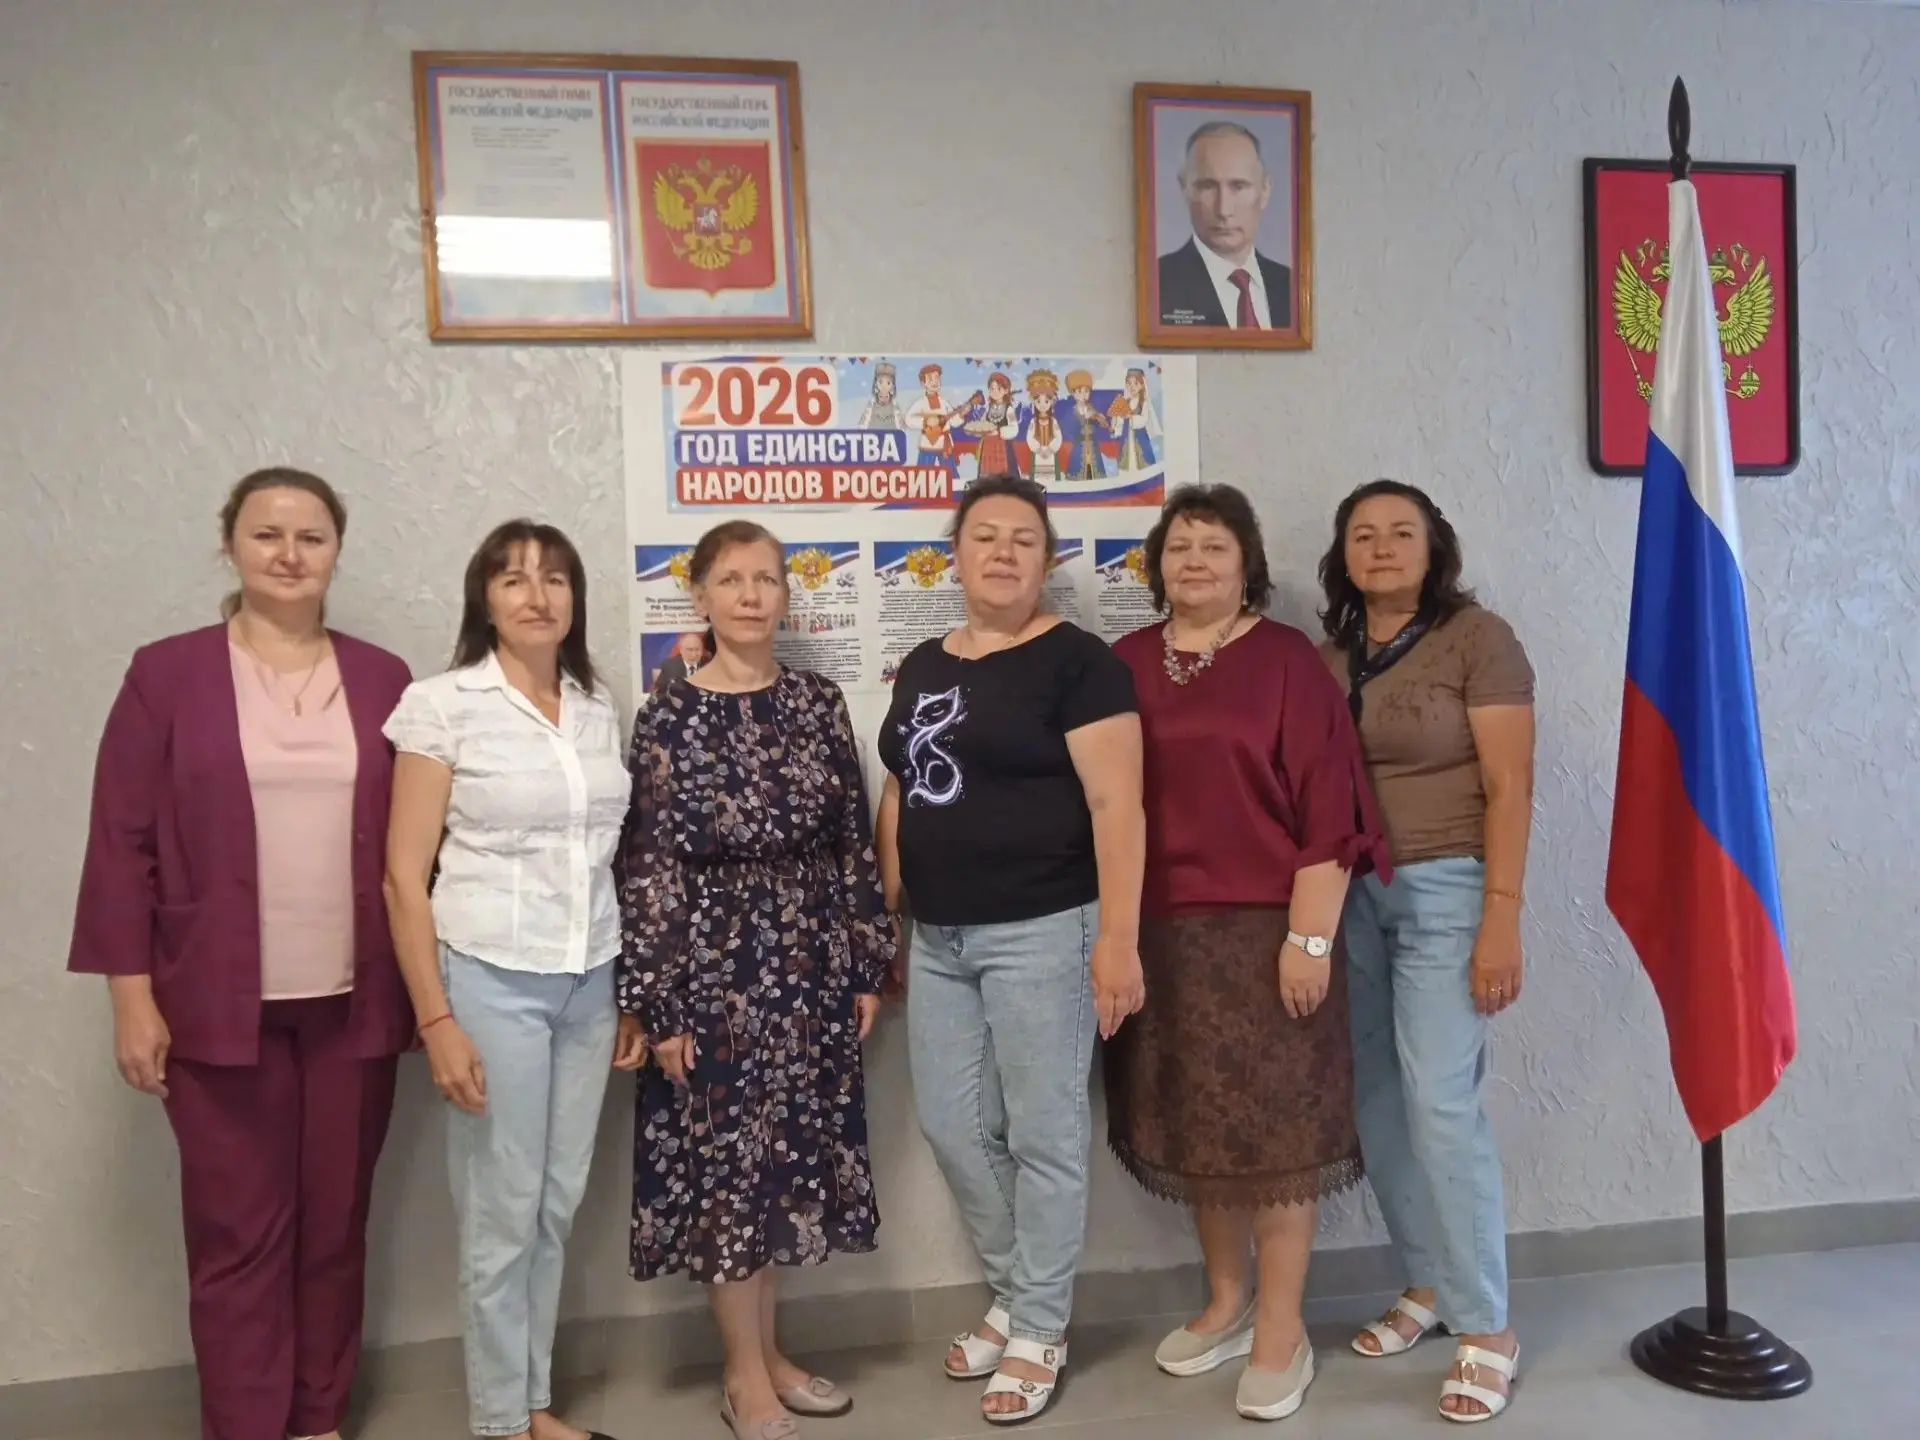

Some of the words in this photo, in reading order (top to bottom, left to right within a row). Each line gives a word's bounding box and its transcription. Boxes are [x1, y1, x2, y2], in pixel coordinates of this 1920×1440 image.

[448, 85, 558, 101] ГОСУДАРСТВЕННЫЙ
[448, 102, 524, 117] РОССИЙСКОЙ
[526, 106, 593, 122] ФЕДЕРАЦИИ
[678, 366, 832, 426] 2026
[680, 433, 739, 466] ГОД
[747, 433, 901, 467] ЕДИНСТВА
[682, 470, 824, 503] НАРОДОВ
[832, 470, 948, 499] РОССИИ
